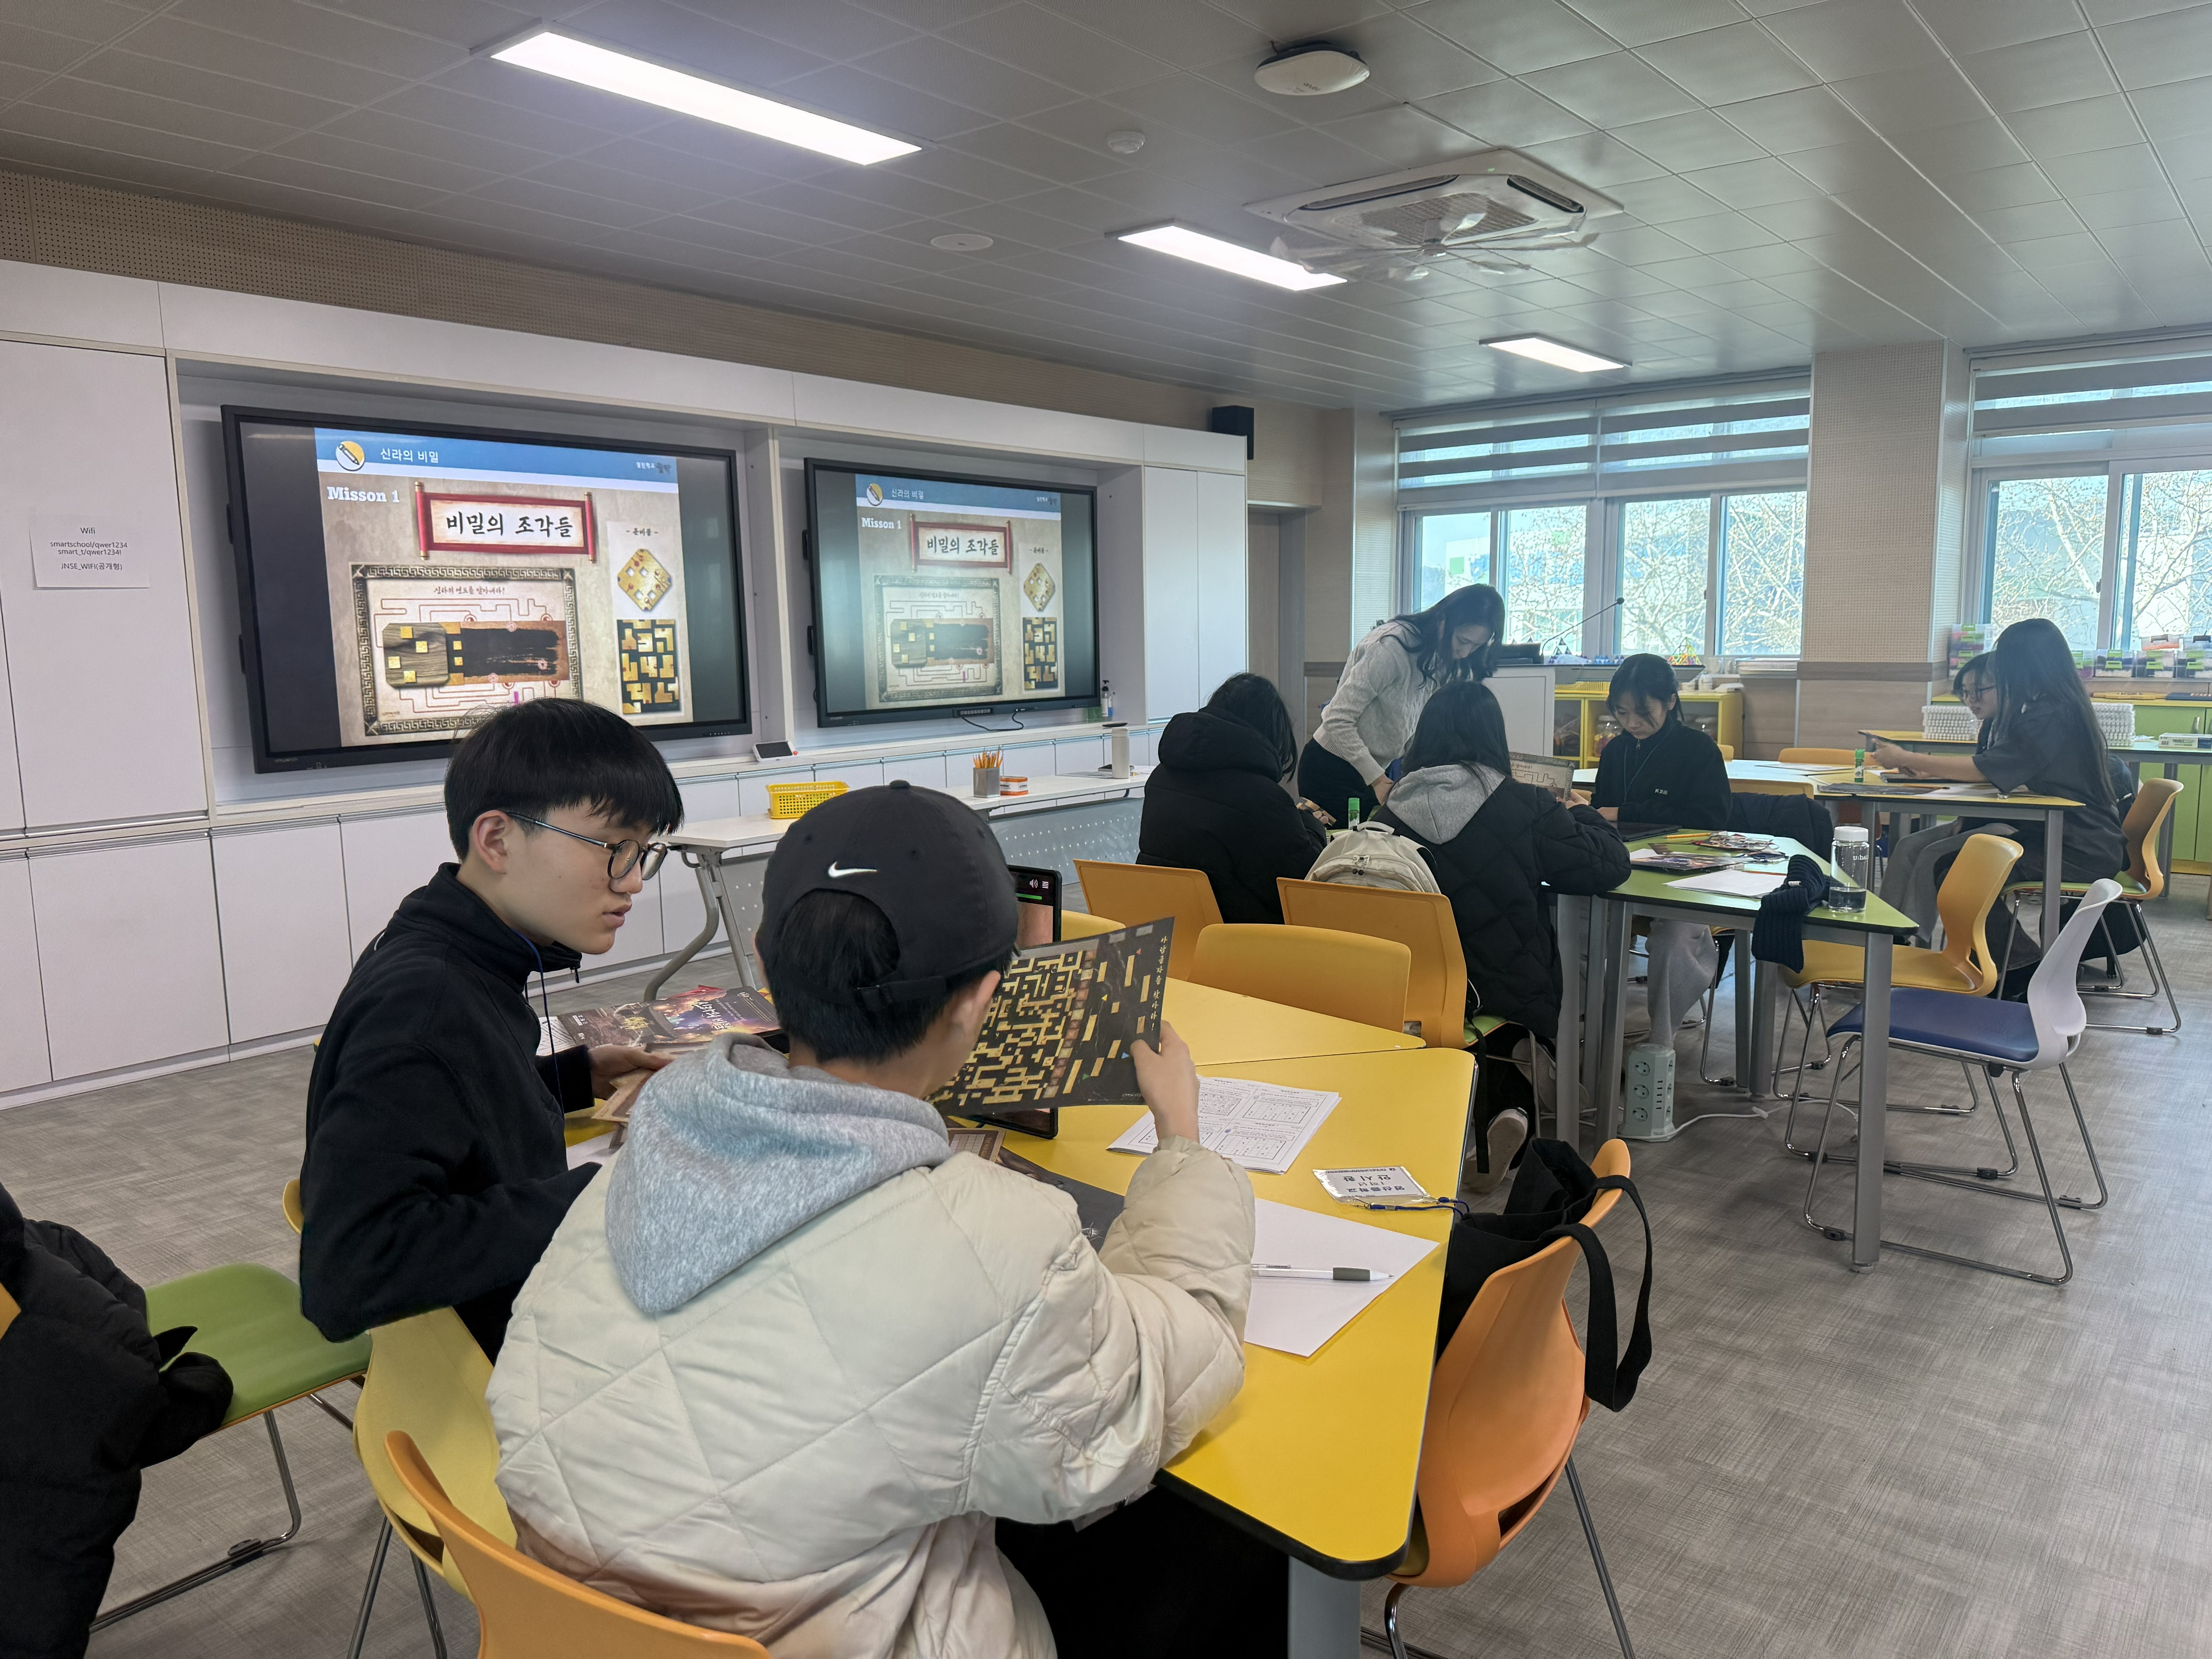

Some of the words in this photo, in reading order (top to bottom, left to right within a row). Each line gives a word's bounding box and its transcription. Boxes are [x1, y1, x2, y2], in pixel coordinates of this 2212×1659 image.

[380, 448, 413, 462] 신라의
[417, 450, 439, 463] 비밀
[327, 486, 387, 502] Misson
[392, 490, 400, 503] 1
[892, 489, 910, 498] 신라의
[446, 511, 503, 536] 비밀의
[515, 515, 573, 538] 조각들
[861, 517, 895, 529] Misson
[896, 520, 902, 529] 1
[927, 536, 960, 554] 비밀의
[966, 538, 999, 555] 조각들
